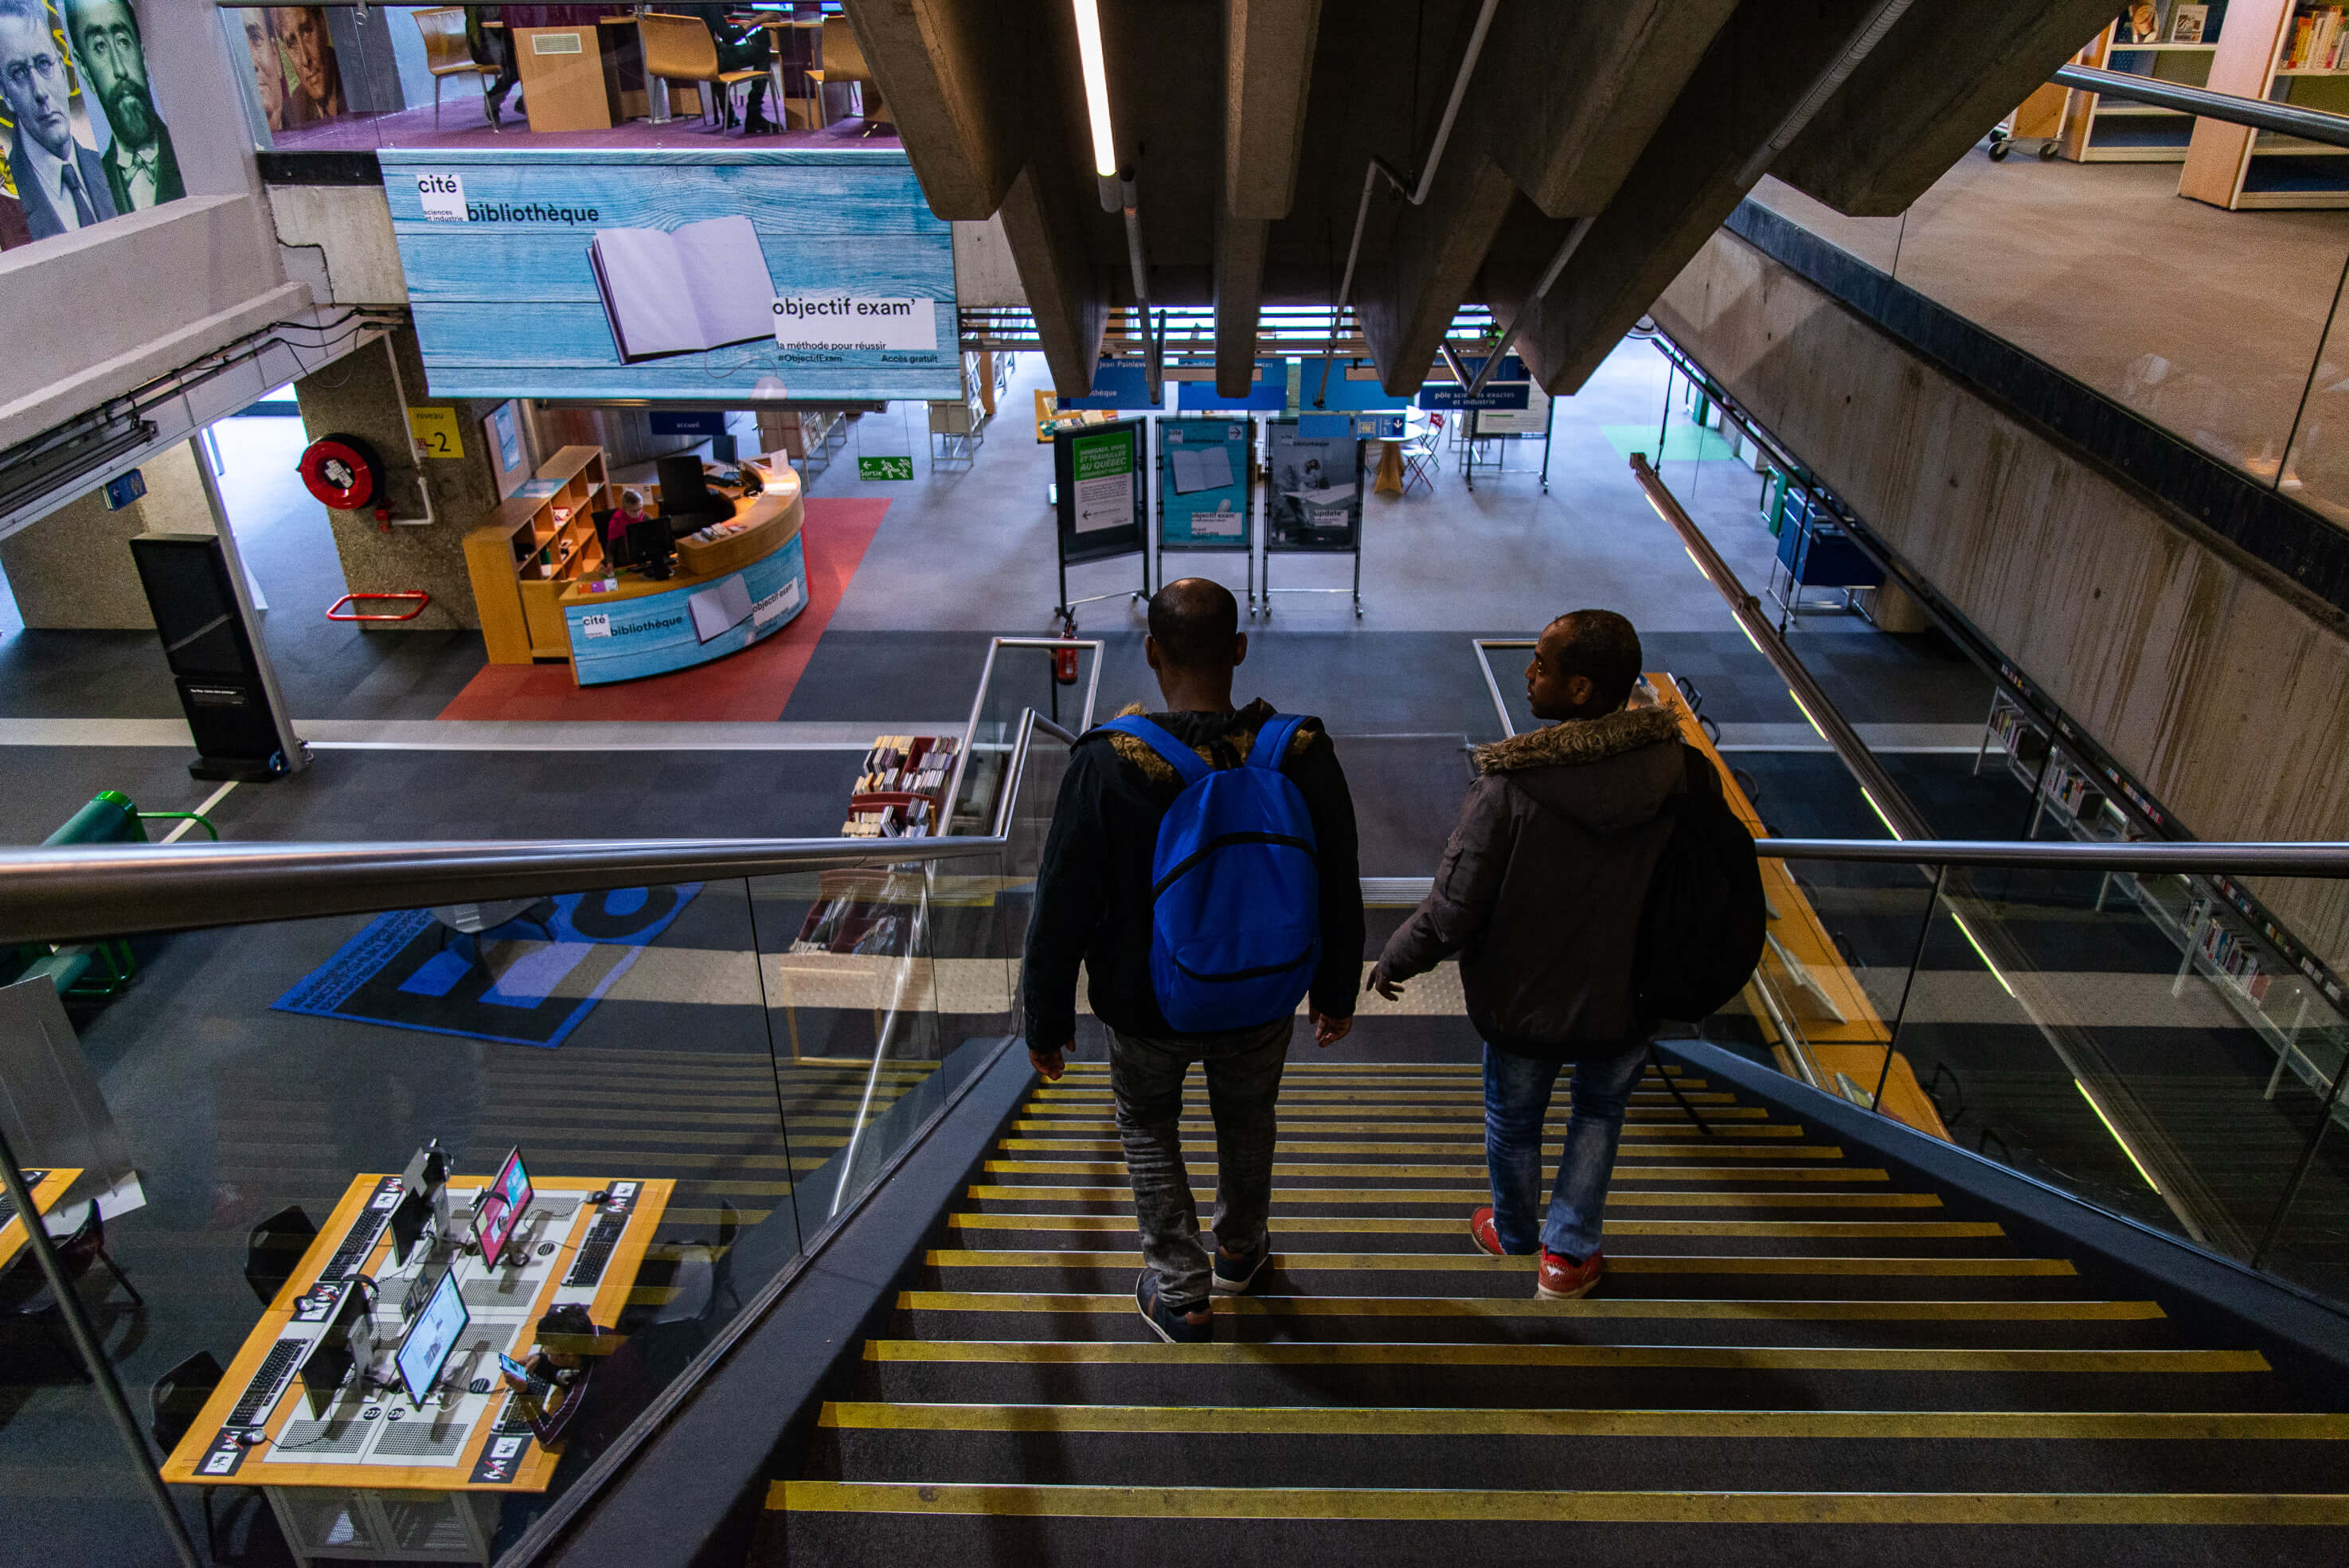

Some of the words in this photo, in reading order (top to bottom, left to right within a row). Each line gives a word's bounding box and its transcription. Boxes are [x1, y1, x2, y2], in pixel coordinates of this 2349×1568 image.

[418, 174, 457, 193] cité
[465, 203, 599, 225] bibliothèque
[772, 298, 850, 319] objectif
[777, 342, 784, 350] la
[787, 342, 829, 350] méthode
[831, 343, 852, 352] pour
[855, 341, 886, 350] réussir
[909, 354, 937, 364] gratuit
[752, 592, 779, 612] objectif
[583, 616, 605, 625] cité
[611, 616, 682, 636] bibliothèque
